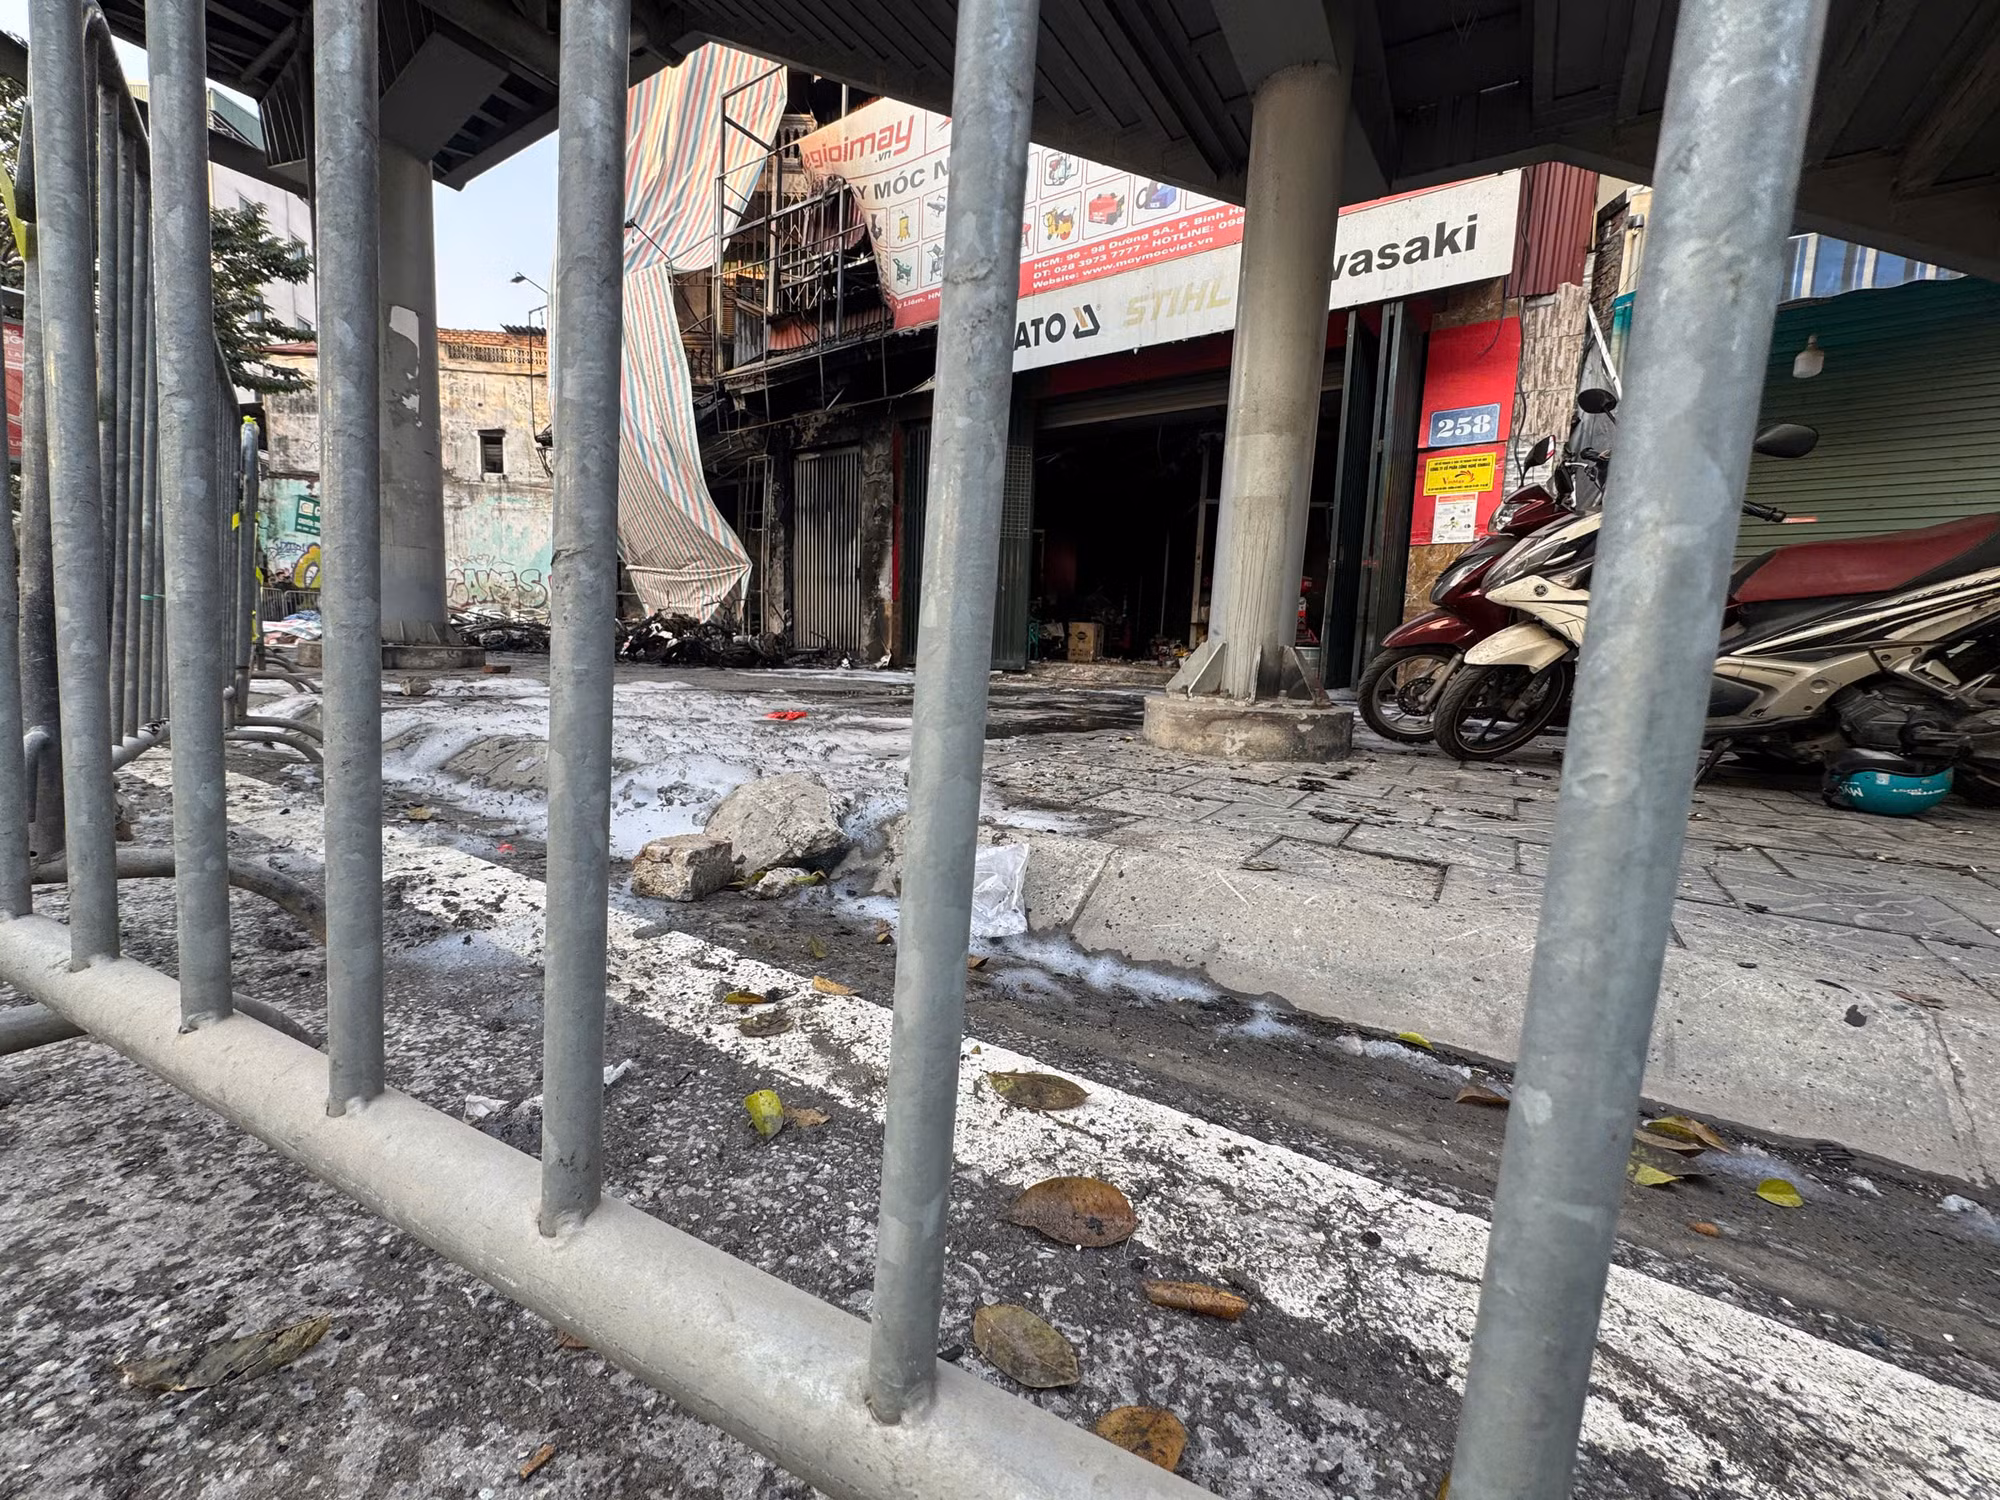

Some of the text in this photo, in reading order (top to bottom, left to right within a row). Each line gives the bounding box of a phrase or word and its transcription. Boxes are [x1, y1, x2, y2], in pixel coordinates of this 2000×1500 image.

[874, 168, 926, 200] MÓC
[1034, 257, 1063, 270] HCM:
[1054, 262, 1075, 274] 028
[1078, 253, 1107, 269] 3973
[1111, 244, 1141, 260] 7777
[1152, 225, 1214, 248] HOTLINE:
[1032, 272, 1079, 289] Website:
[1123, 279, 1231, 327] STIHL
[1436, 414, 1491, 439] 258
